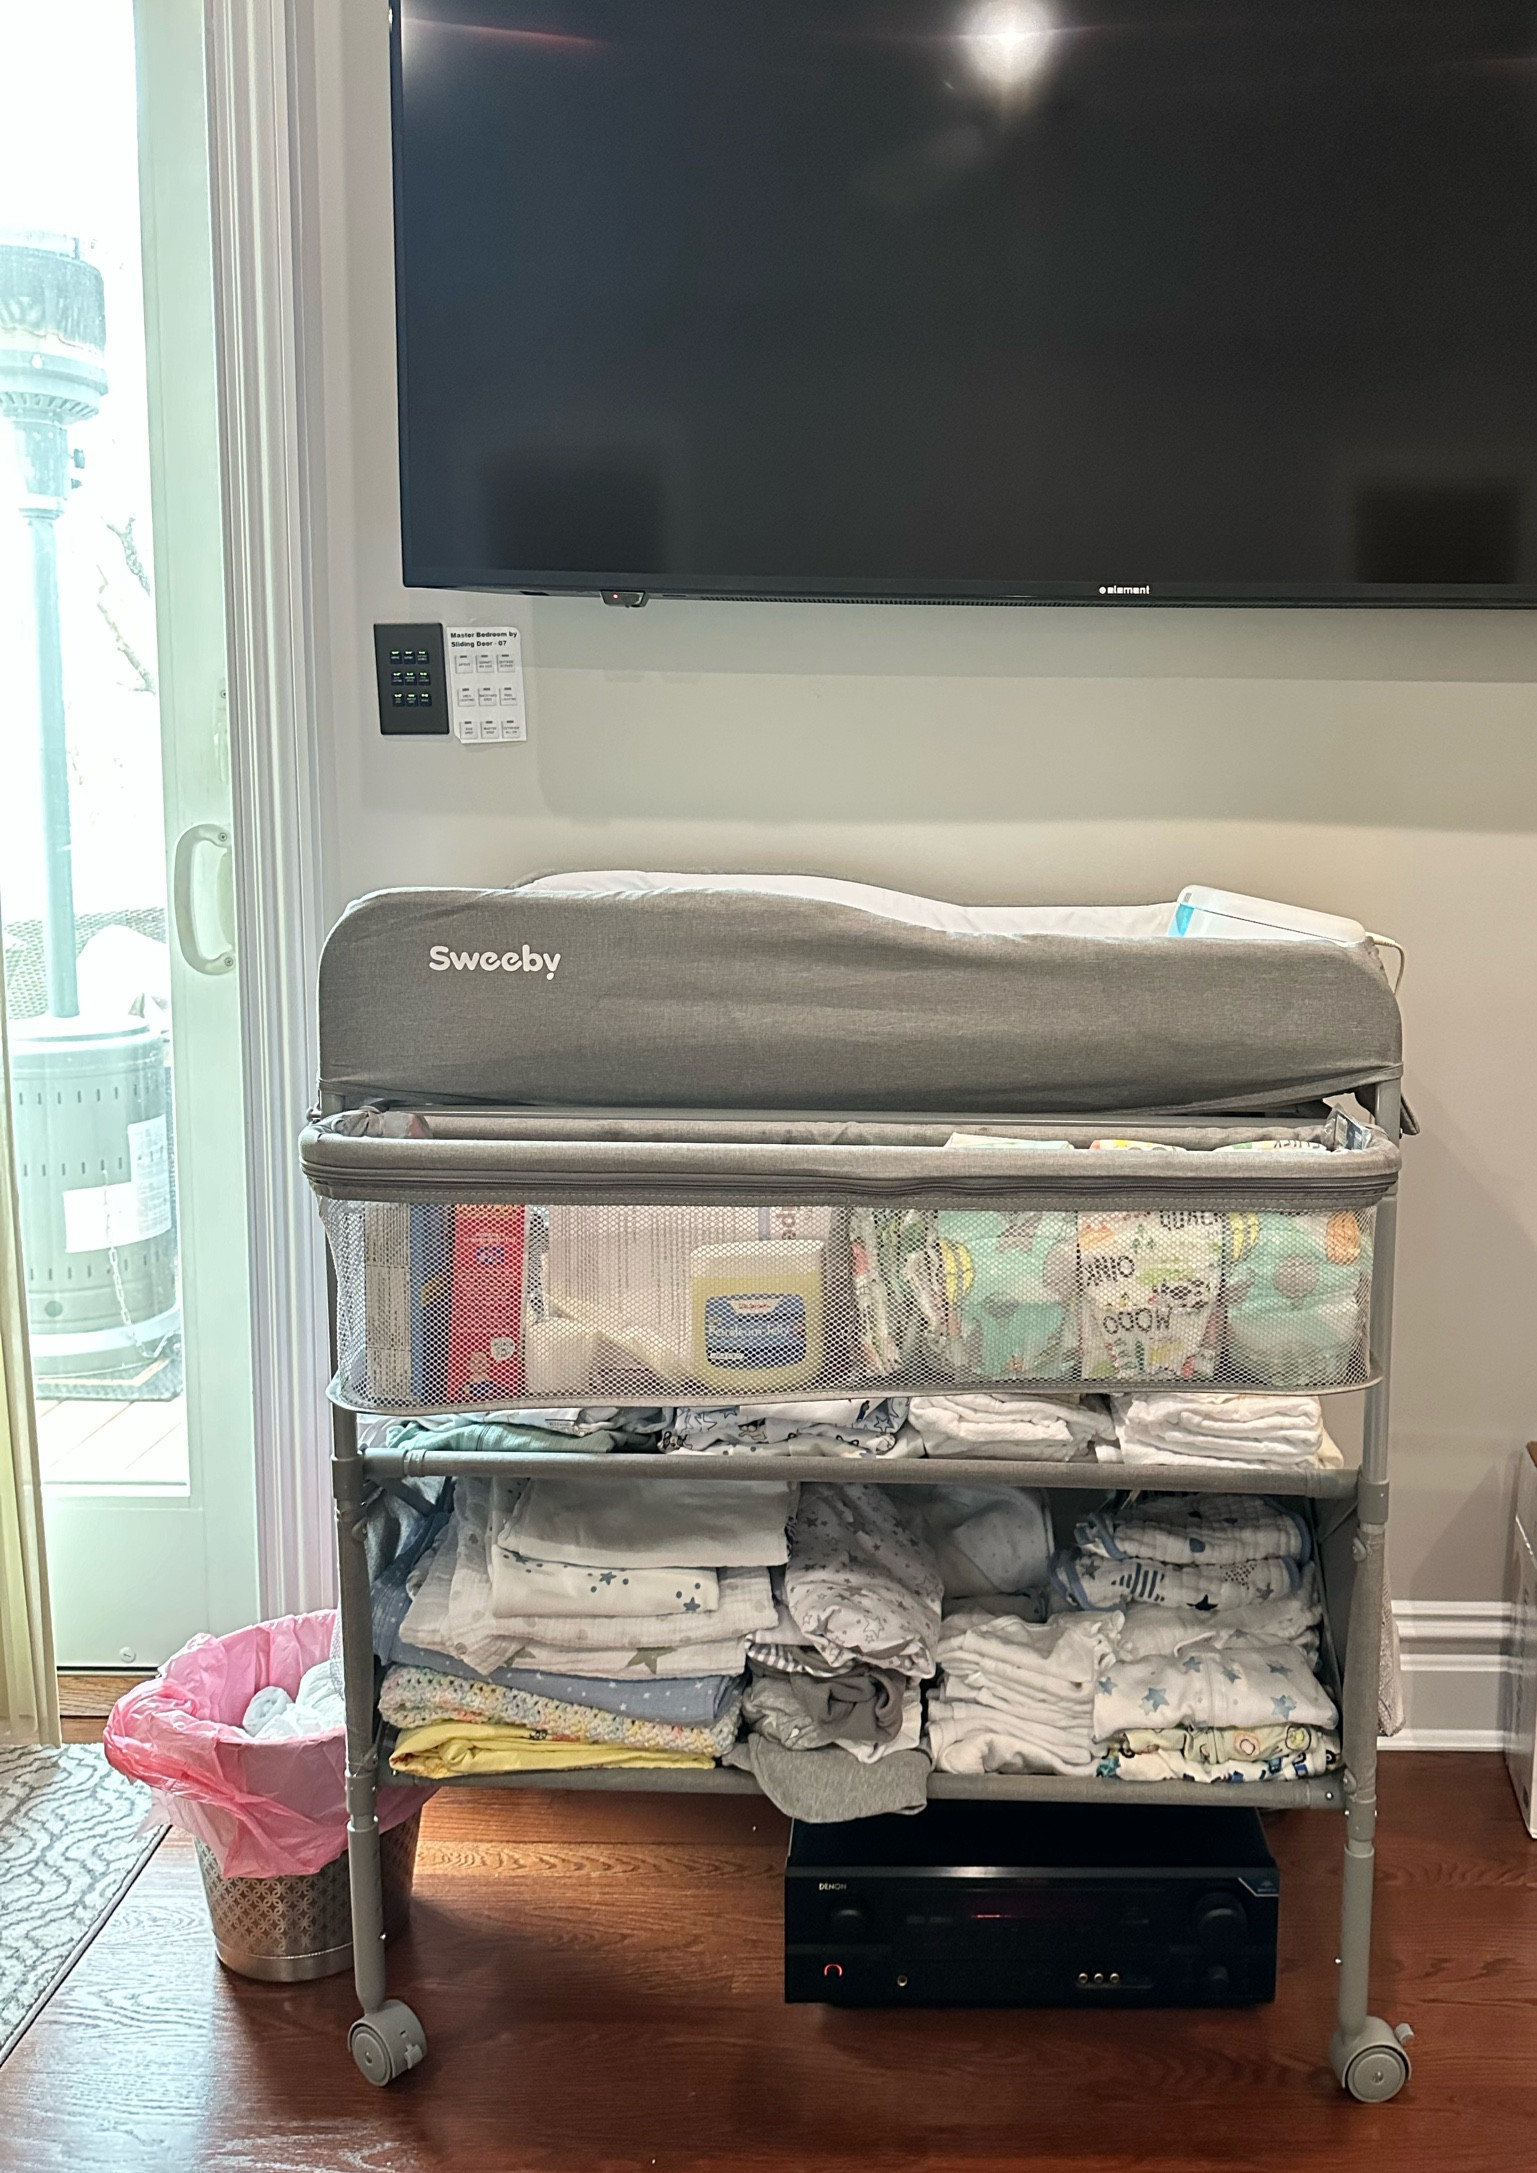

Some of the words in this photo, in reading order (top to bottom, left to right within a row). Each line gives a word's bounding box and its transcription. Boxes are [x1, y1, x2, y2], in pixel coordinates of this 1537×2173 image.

[1107, 585, 1150, 594] element
[429, 944, 561, 980] Sweeby
[818, 1882, 847, 1891] DENON
